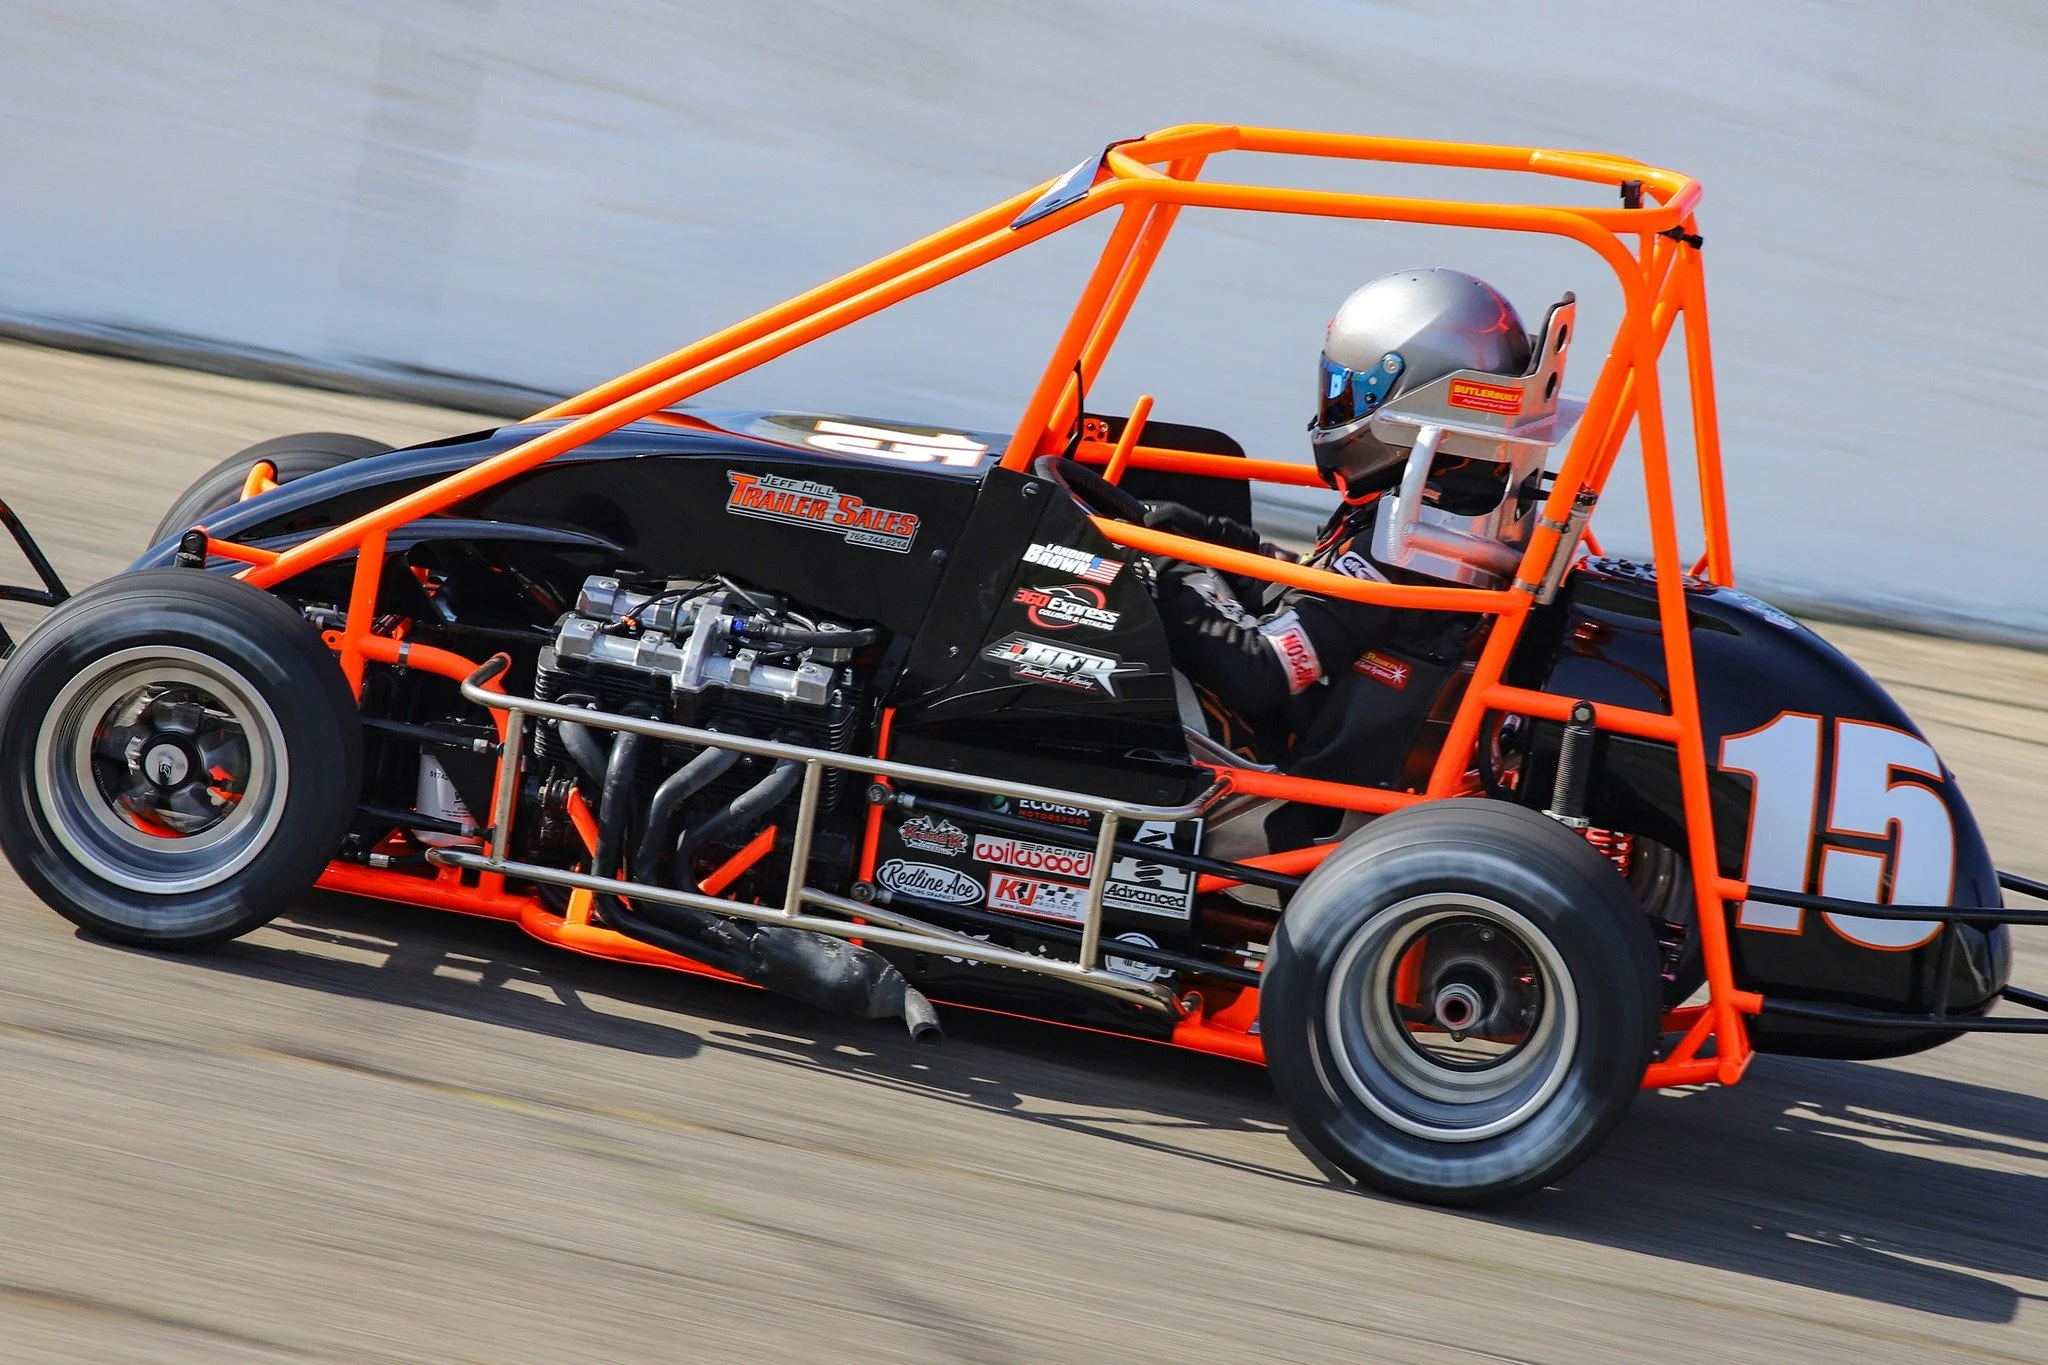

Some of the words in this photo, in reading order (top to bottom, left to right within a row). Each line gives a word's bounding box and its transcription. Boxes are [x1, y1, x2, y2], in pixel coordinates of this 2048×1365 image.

[804, 419, 988, 468] 15
[761, 474, 796, 489] JEFF
[803, 482, 835, 496] HILL
[833, 495, 918, 536] SALES
[1022, 543, 1091, 576] BROWN
[1044, 543, 1096, 563] LANDON
[1013, 588, 1054, 608] 360
[1047, 597, 1120, 624] Express
[1038, 608, 1074, 622] COLLISION
[1079, 618, 1115, 630] DETAILING
[1717, 710, 1956, 952] 15
[976, 842, 1092, 876] wilwood
[1034, 843, 1086, 859] RACING
[886, 862, 944, 892] Redline
[944, 873, 974, 898] Ace
[1104, 883, 1187, 908] Advanced
[1035, 895, 1080, 908] RACE
